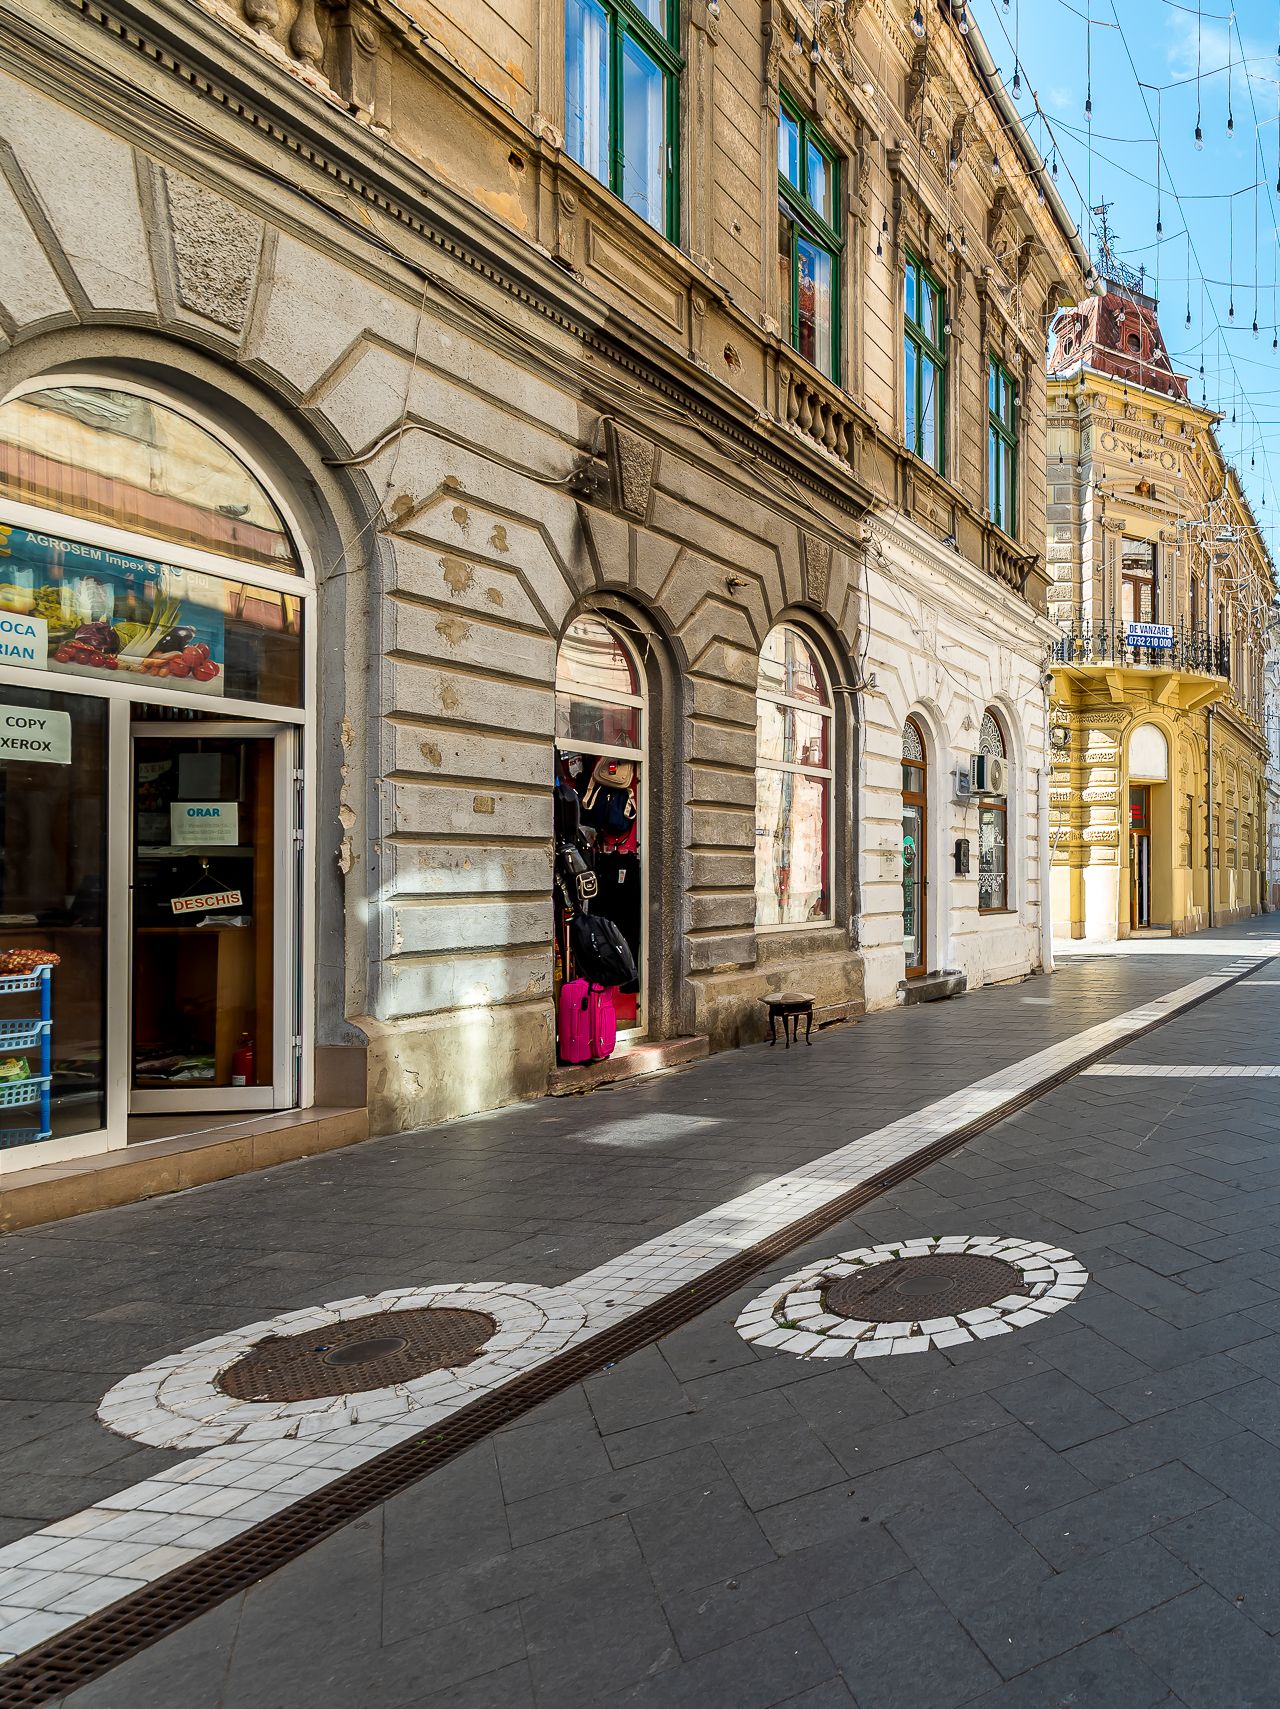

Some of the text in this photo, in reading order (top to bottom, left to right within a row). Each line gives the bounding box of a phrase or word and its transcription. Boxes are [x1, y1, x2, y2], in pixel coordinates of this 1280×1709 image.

[25, 532, 102, 561] AGROSEM
[105, 553, 144, 573] Impex
[1129, 624, 1169, 636] DE VANZARE
[1128, 636, 1145, 646] 0732
[1147, 638, 1158, 647] 210
[6, 716, 46, 730] COPY
[0, 737, 52, 752] XEROX
[187, 808, 220, 817] ORAR
[173, 892, 241, 912] DESCHIS
